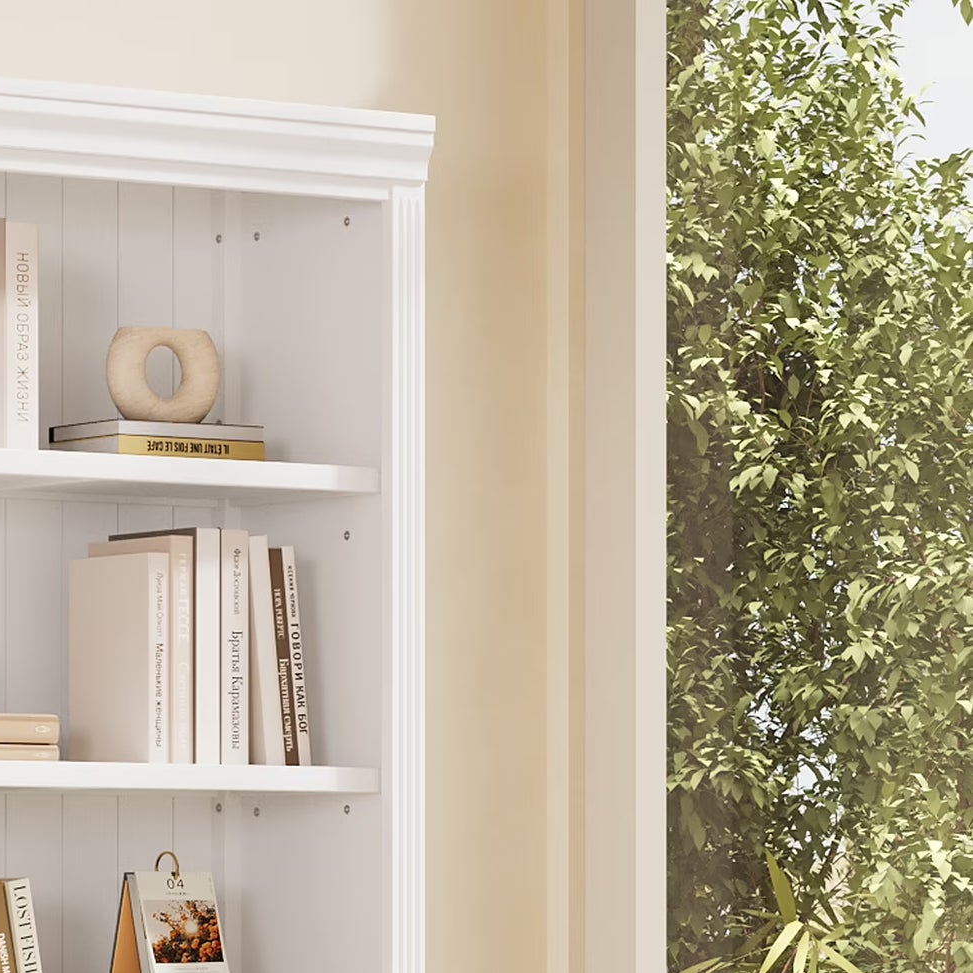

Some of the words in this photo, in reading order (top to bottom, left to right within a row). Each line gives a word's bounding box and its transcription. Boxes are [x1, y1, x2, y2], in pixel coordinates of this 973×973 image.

[16, 252, 31, 307] НОВЫЙ
[16, 313, 30, 361] ОБРАЗ
[16, 367, 30, 422] ЖИЗНИ
[165, 442, 172, 452] LE
[174, 442, 188, 453] FOIS
[190, 443, 203, 454] UNE
[155, 643, 164, 697] Маленькие
[228, 631, 243, 673] Братья
[291, 623, 303, 680] ГОВОРИ
[277, 658, 291, 714] Бархатная
[295, 686, 305, 708] КАК
[154, 699, 164, 747] женщины
[228, 676, 243, 749] Карамазовы
[283, 715, 293, 752] смерть
[297, 714, 308, 734] БОГ
[166, 878, 185, 890] 04
[14, 885, 32, 929] LOST
[21, 935, 37, 973] FISH
